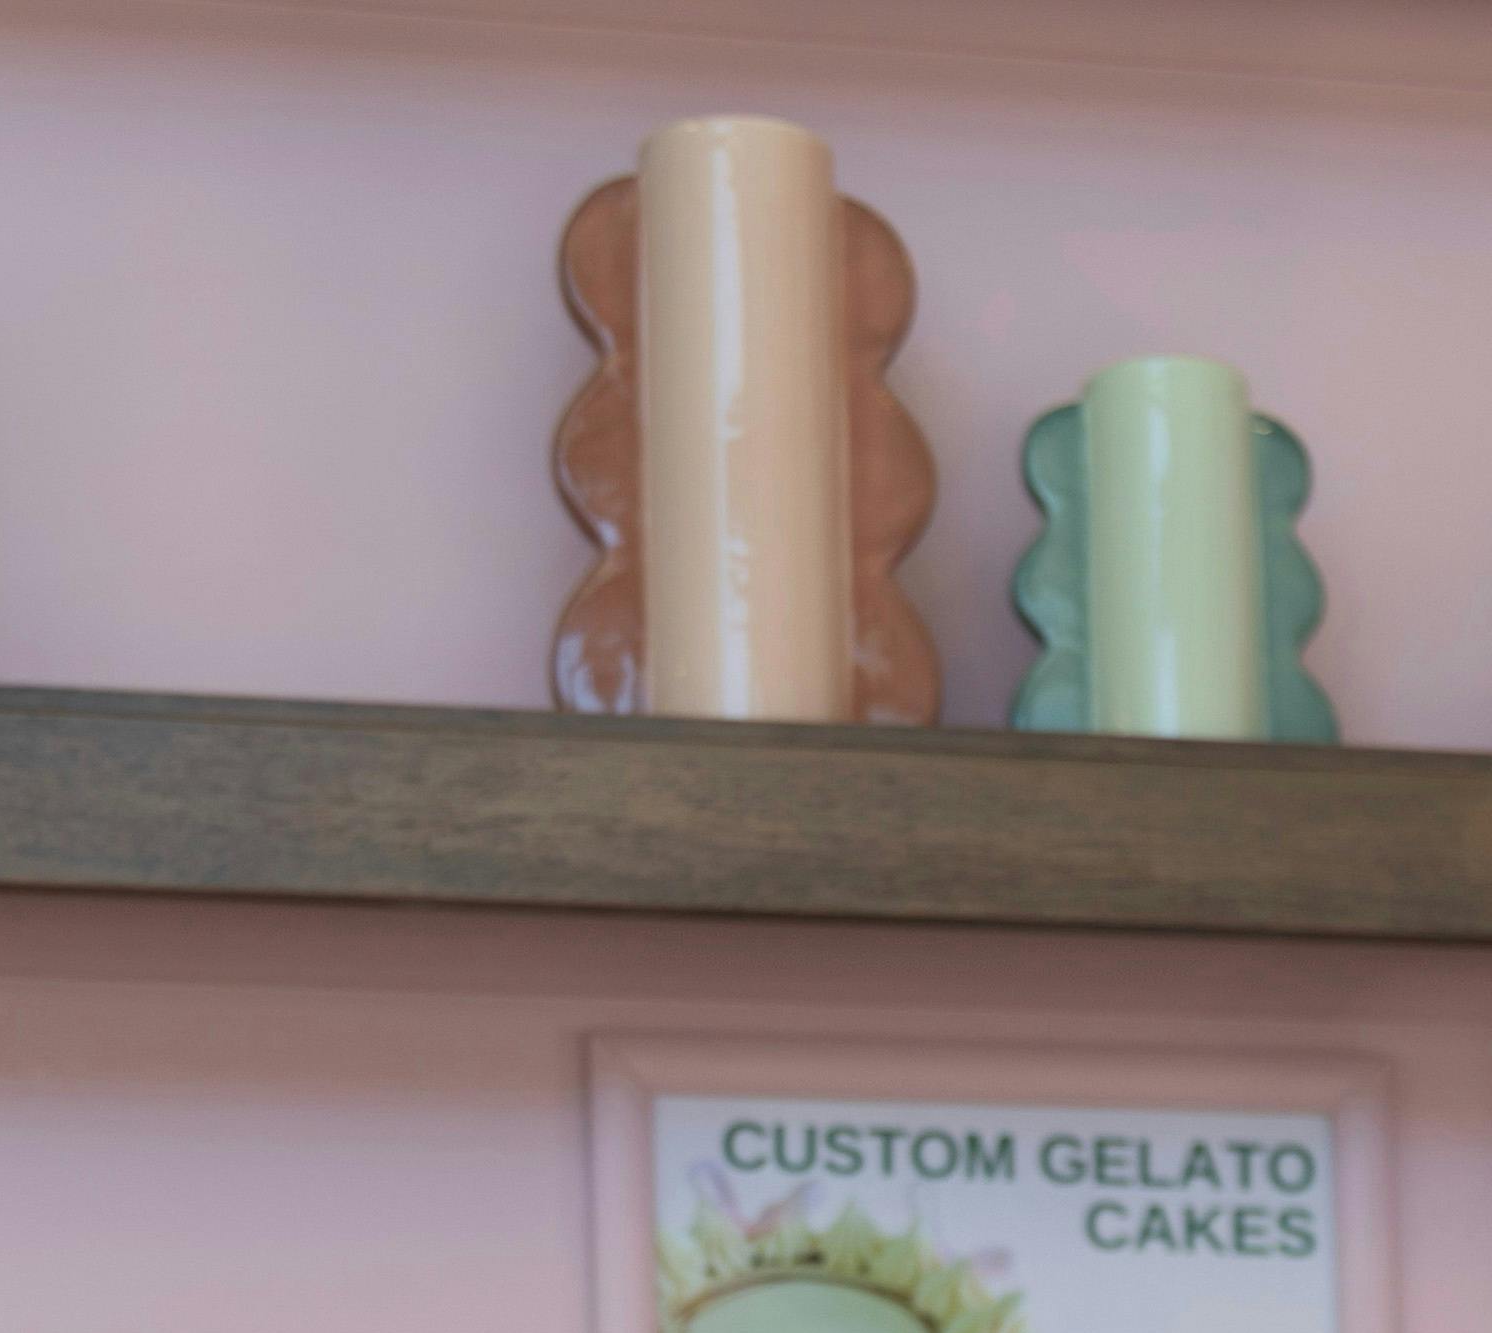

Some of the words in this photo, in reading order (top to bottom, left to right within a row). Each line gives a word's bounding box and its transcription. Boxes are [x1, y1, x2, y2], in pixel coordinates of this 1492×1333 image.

[720, 1120, 1016, 1181] CUSTOM
[1037, 1132, 1317, 1195] GELATO
[1083, 1199, 1317, 1258] CAKES
